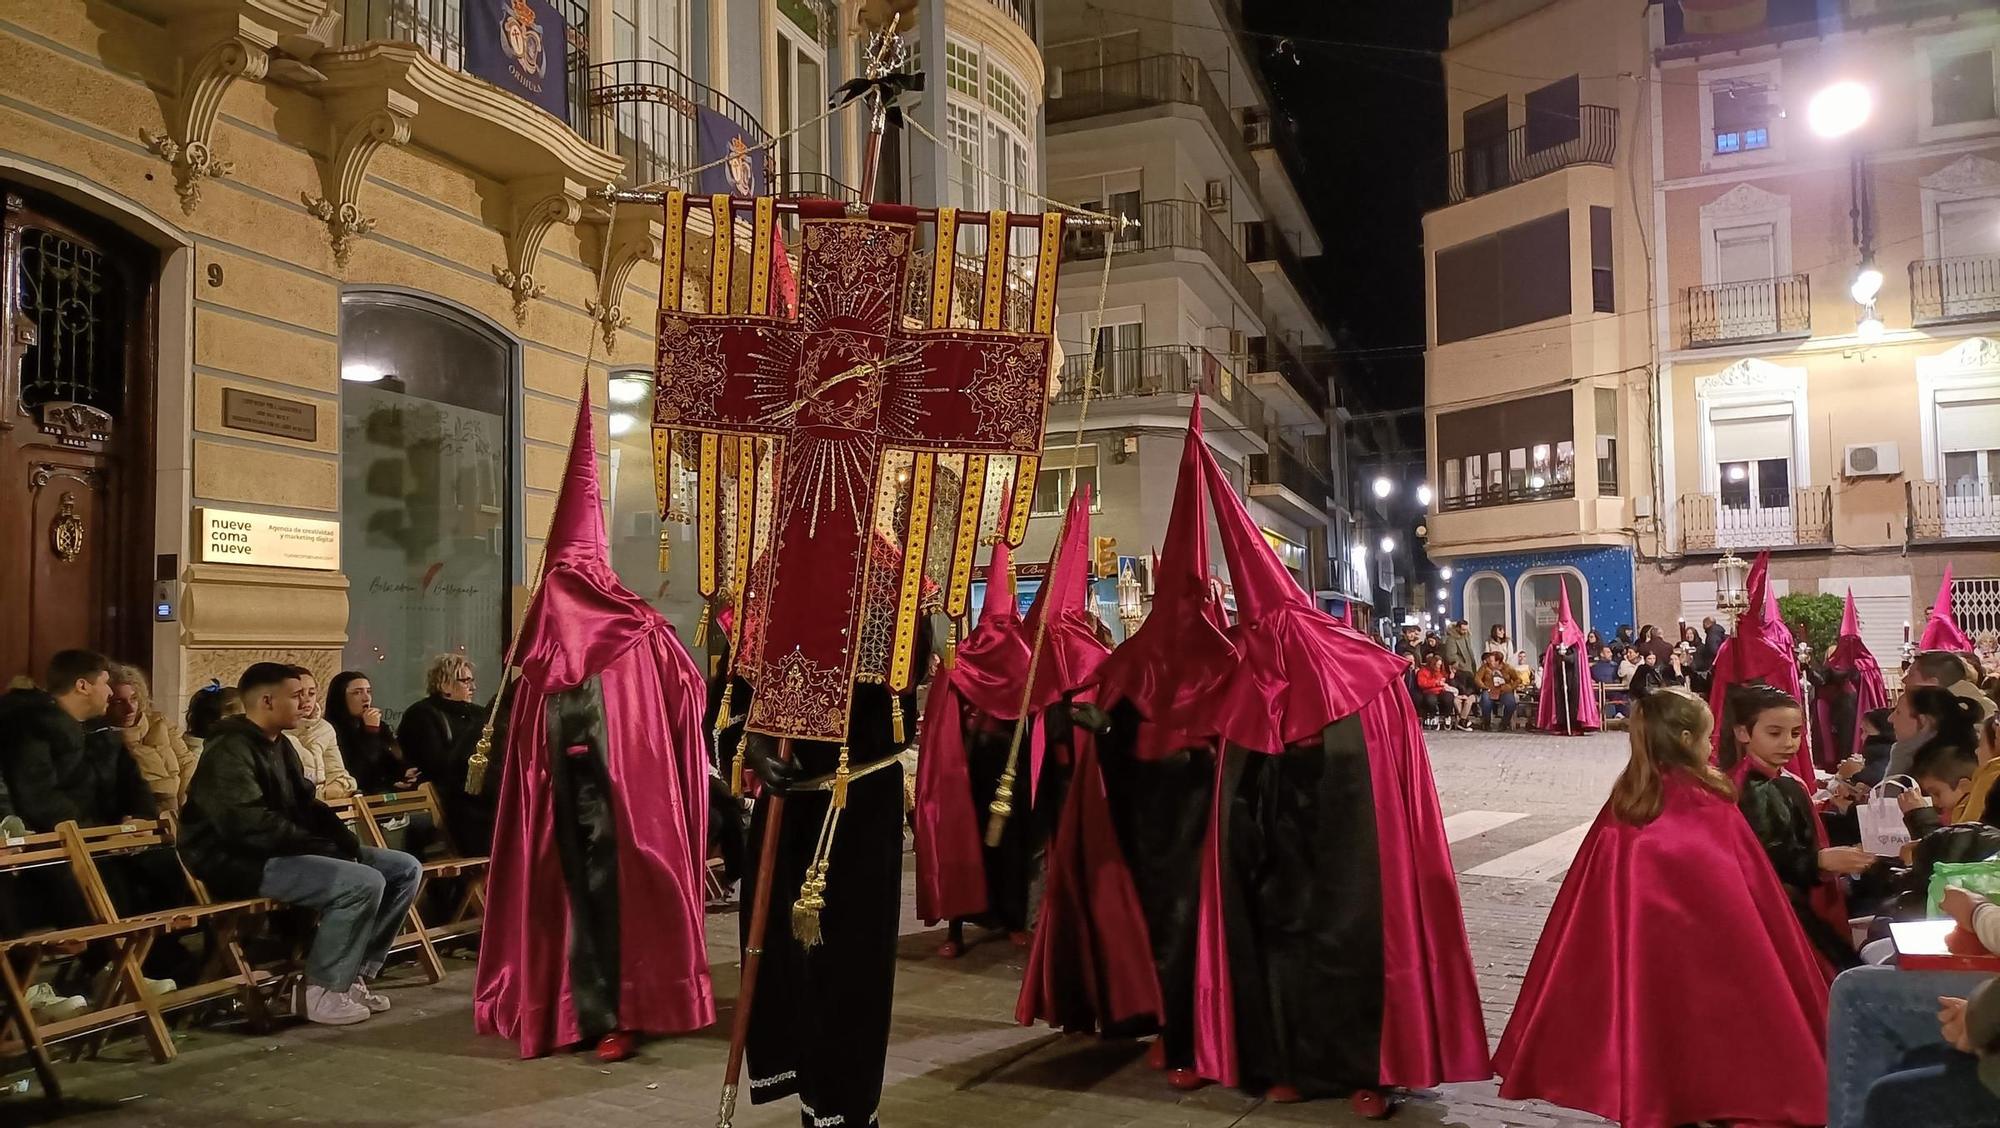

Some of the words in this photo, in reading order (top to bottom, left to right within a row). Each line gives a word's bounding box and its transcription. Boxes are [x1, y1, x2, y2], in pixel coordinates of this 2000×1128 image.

[207, 263, 223, 288] 9
[211, 519, 252, 531] nueve
[268, 524, 293, 533] Agencia
[302, 527, 334, 536] creatividad
[211, 531, 248, 543] coma
[285, 533, 315, 543] marketing
[316, 535, 334, 543] digital
[211, 543, 252, 554] nueve
